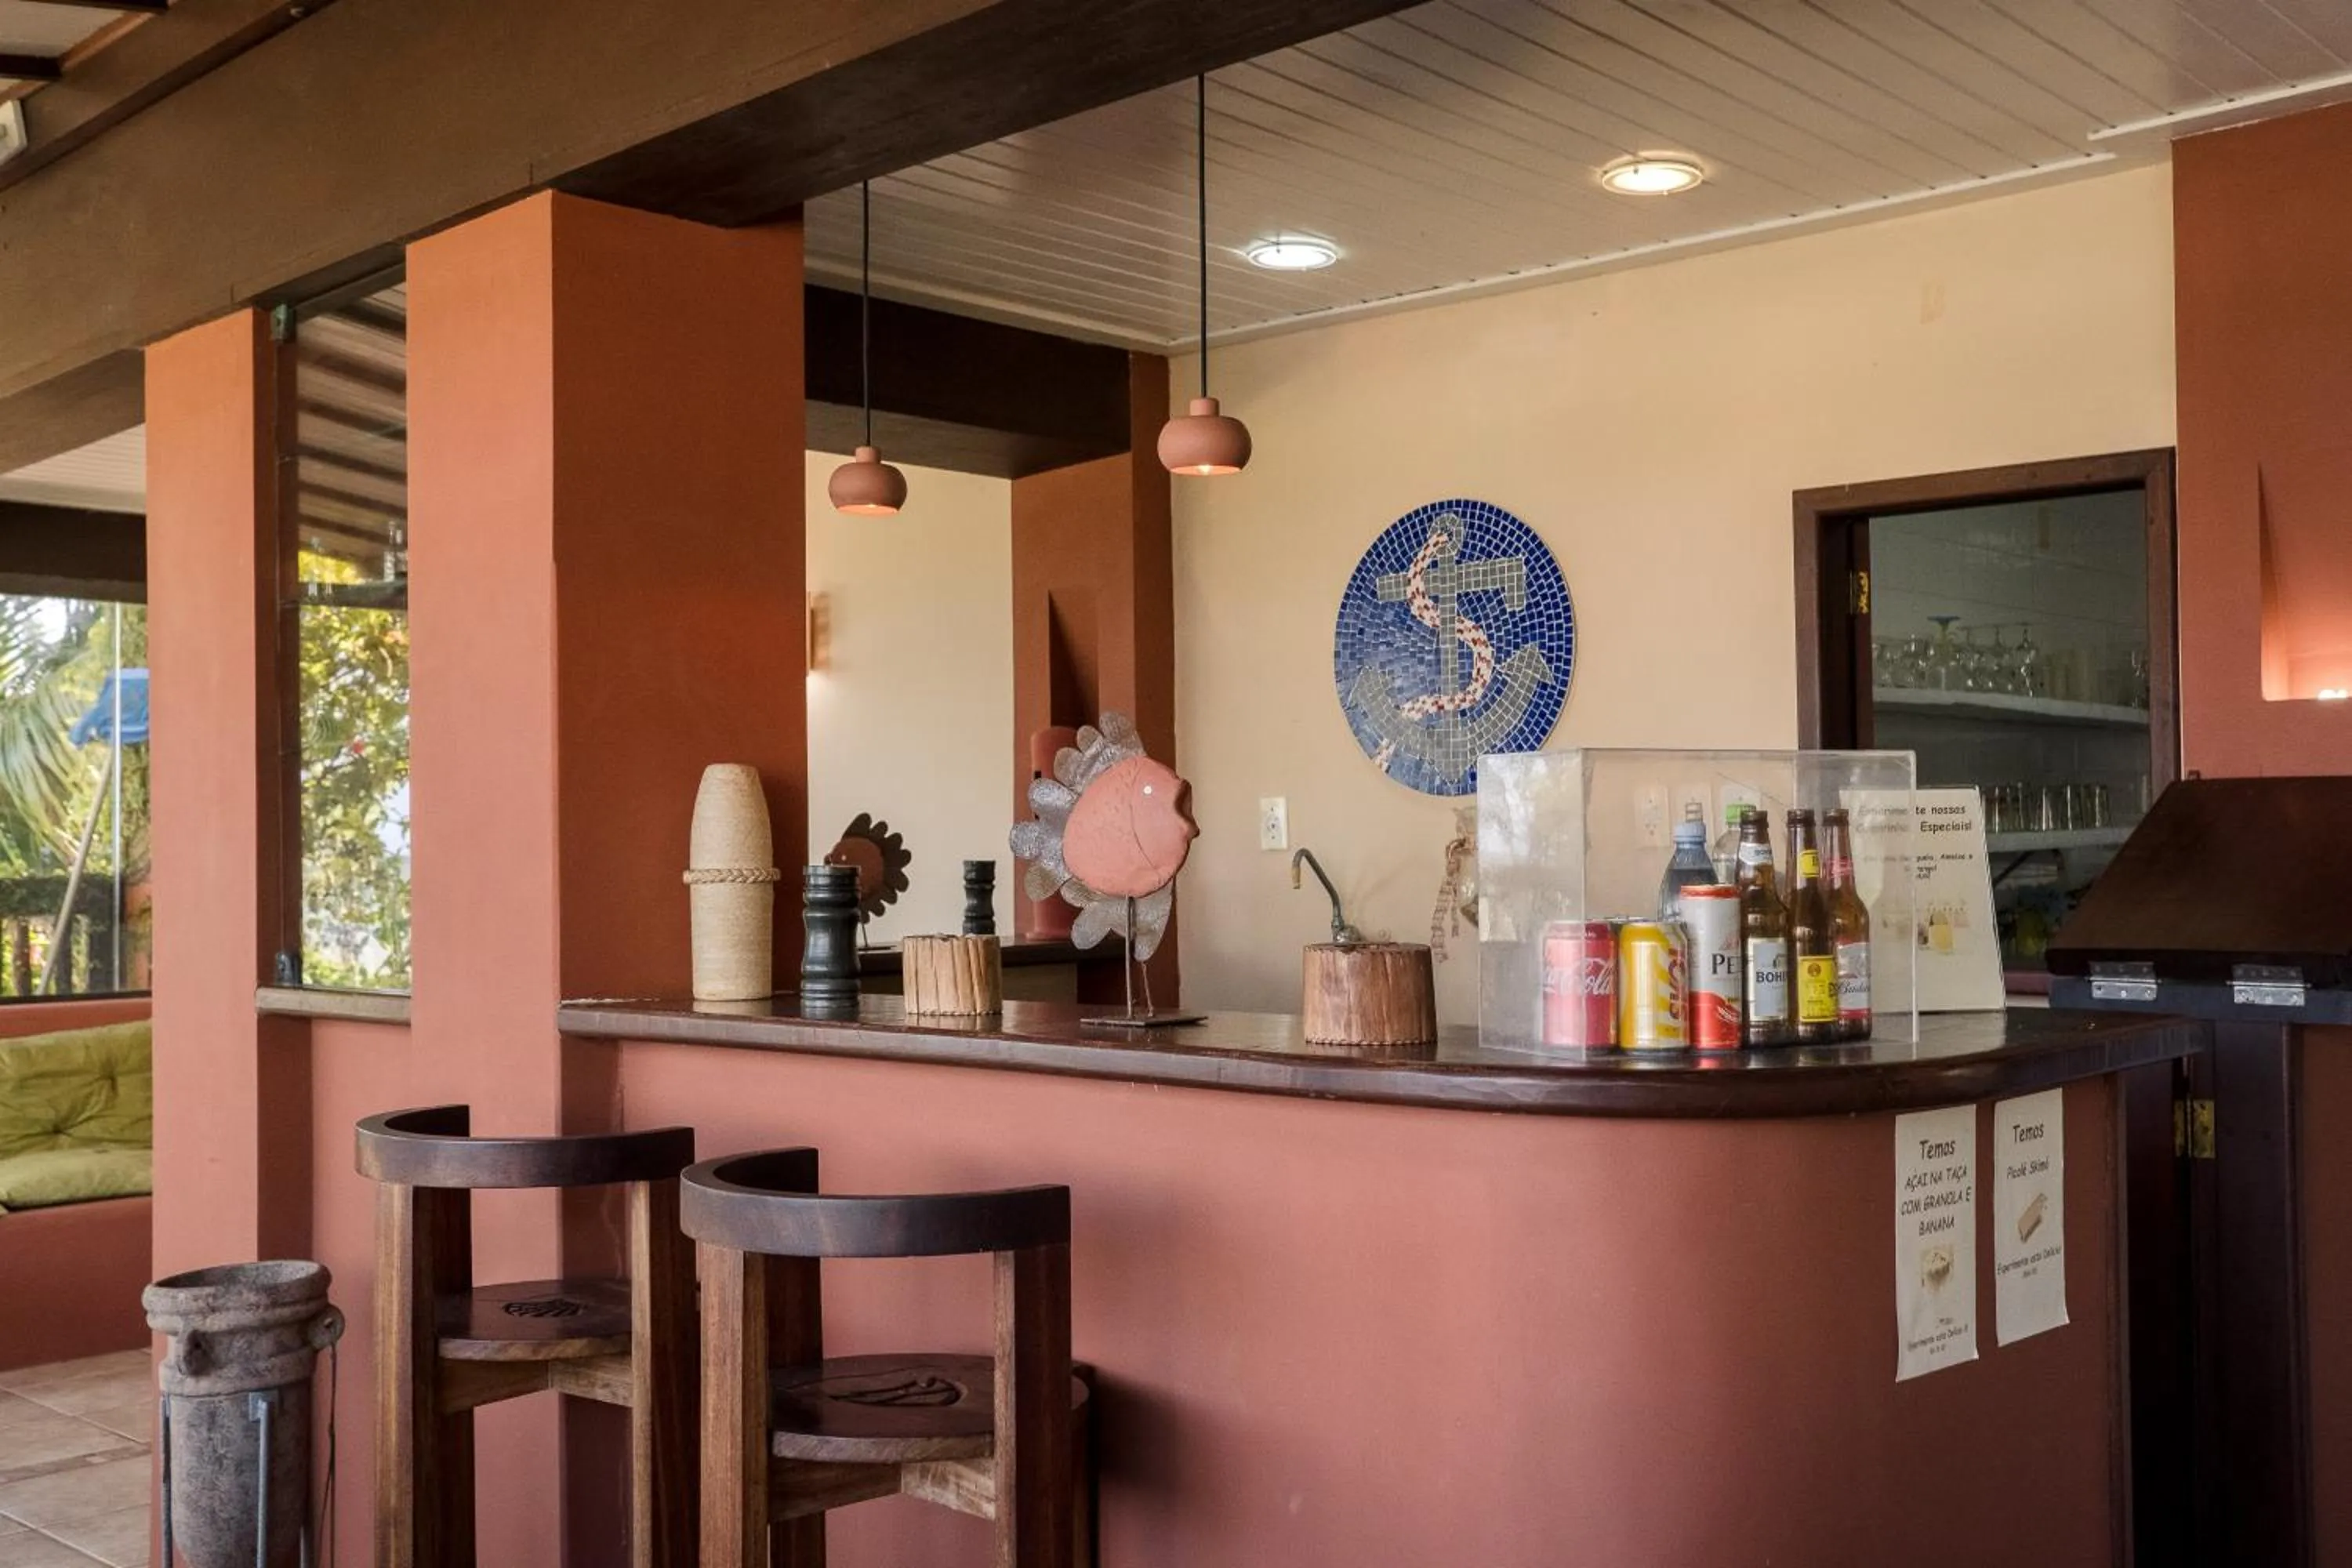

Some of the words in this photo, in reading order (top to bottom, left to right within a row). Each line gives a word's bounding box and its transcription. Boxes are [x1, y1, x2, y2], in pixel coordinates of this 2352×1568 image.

[1931, 805, 1966, 815] nossas
[2013, 1123, 2045, 1143] Temos
[1919, 1140, 1955, 1160] Temos
[1929, 1171, 1943, 1185] NA
[1946, 1164, 1967, 1183] TAÇA
[1901, 1199, 1922, 1216] COM
[1923, 1190, 1962, 1211] GRANOLA
[1918, 1216, 1955, 1236] BANANA
